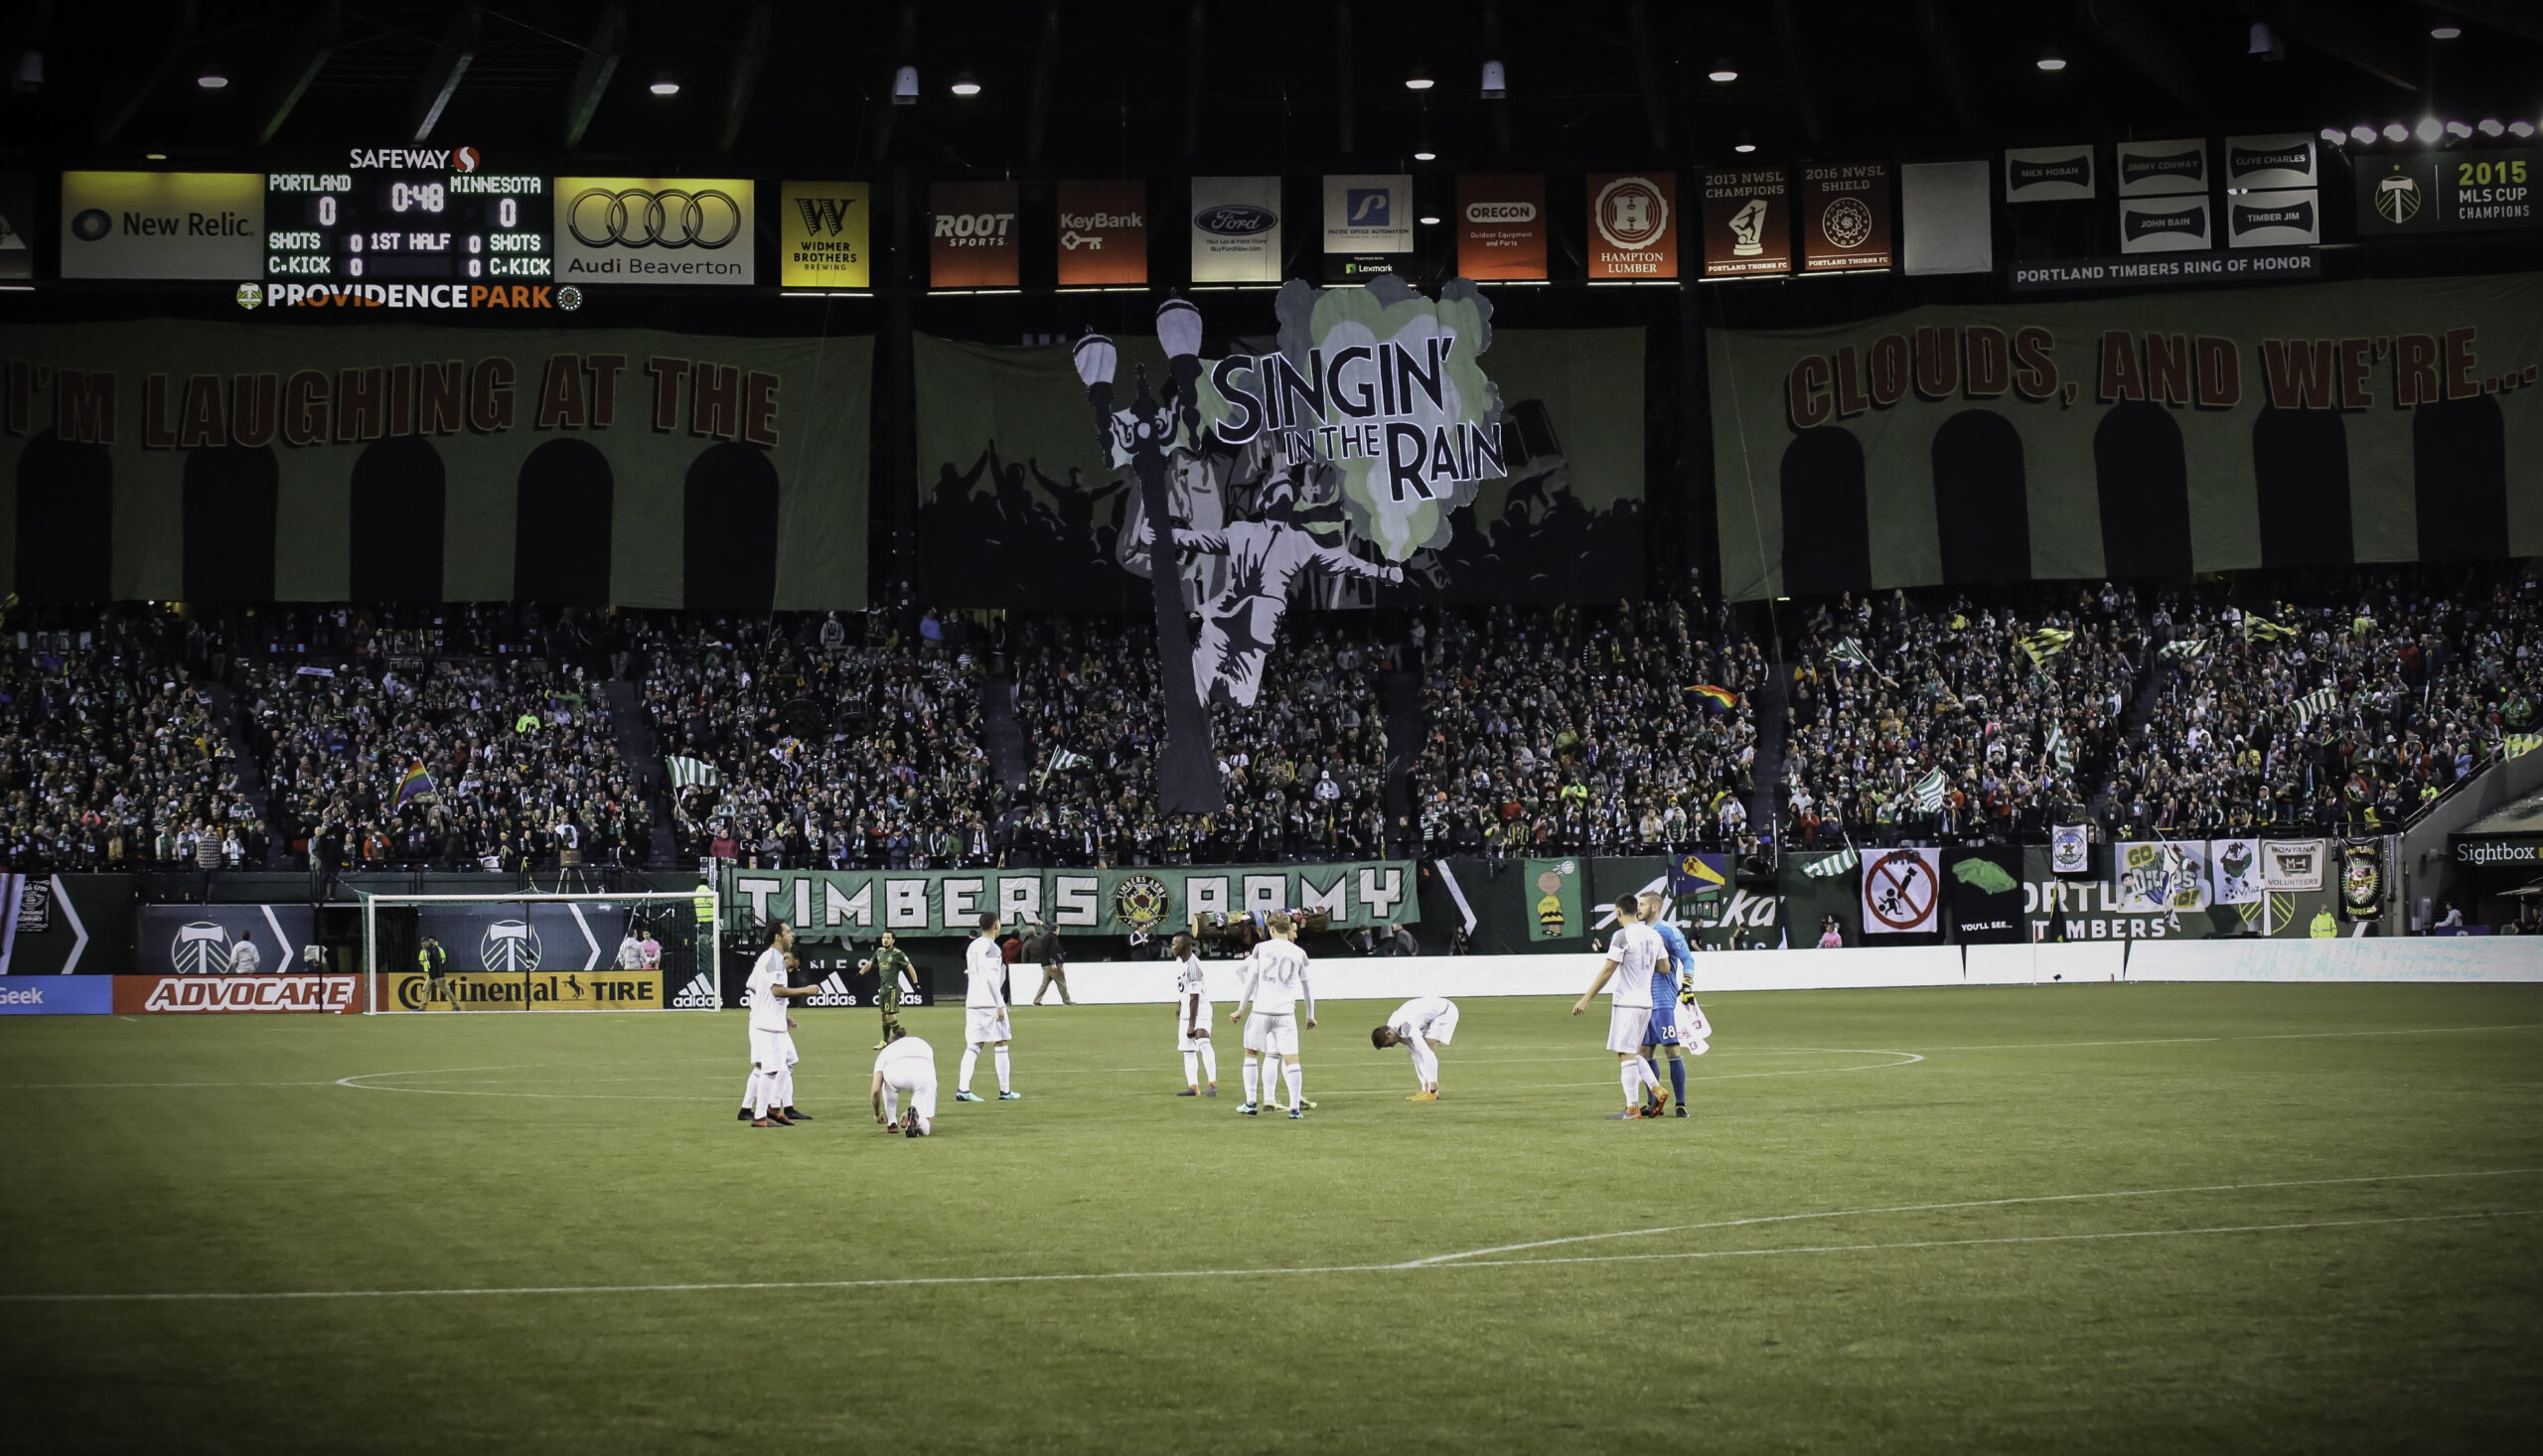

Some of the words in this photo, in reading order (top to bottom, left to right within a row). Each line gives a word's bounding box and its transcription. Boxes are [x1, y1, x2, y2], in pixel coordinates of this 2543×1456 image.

[350, 149, 450, 169] SAFEWAY
[2127, 162, 2156, 173] JIMMY
[2158, 159, 2199, 171] CONWAY
[2236, 156, 2264, 166] CLIVE
[2266, 153, 2307, 164] CHARLES
[1706, 174, 1737, 186] 2013
[1741, 172, 1784, 184] NWSL
[1805, 168, 1839, 180] 2016
[1843, 166, 1885, 178] NWSL
[2021, 168, 2044, 178] MICK
[2047, 165, 2079, 176] HOBAN
[2459, 161, 2526, 186] 2015
[269, 174, 351, 192] PORTLAND
[450, 176, 541, 195] MINNESOTA
[1706, 184, 1785, 199] CHAMPIONS
[1821, 179, 1870, 192] SHIELD
[391, 183, 444, 213] 0:48
[2458, 189, 2489, 204] MLS
[2493, 187, 2528, 203] CUP
[319, 197, 336, 225] 0
[500, 198, 517, 226] 0
[1211, 210, 1261, 230] Ford
[1470, 205, 1531, 219] OREGON
[2247, 213, 2281, 222] TIMBER
[2284, 211, 2301, 221] JIM
[2459, 204, 2530, 220] CHAMPIONS
[123, 213, 179, 236] New
[189, 212, 249, 237] Relic
[935, 214, 1014, 237] ROOT
[1061, 213, 1142, 231] KeyBank
[2141, 218, 2164, 228] JOHN
[2166, 216, 2190, 226] BAIN
[269, 232, 321, 250] SHOTS
[350, 233, 363, 252] 0
[371, 232, 399, 250] 1ST
[409, 232, 451, 250] HALF
[469, 235, 481, 254] 0
[490, 233, 541, 251] SHOTS
[801, 241, 850, 252] WIDMER
[950, 237, 1006, 247] SPORTS
[269, 256, 331, 274] C.KICK
[350, 257, 363, 276] 0
[568, 258, 622, 274] Audi
[629, 258, 742, 275] Beaverton
[794, 252, 857, 263] BROTHERS
[1601, 252, 1664, 263] HAMPTON
[469, 258, 481, 277] 0
[490, 258, 550, 277] C.KICK
[1359, 263, 1393, 273] Lexmark
[1607, 263, 1657, 274] LUMBER
[1708, 264, 1745, 273] PORTLAND
[1746, 263, 1775, 272] THORNS
[2017, 266, 2104, 283] PORTLAND
[2108, 262, 2179, 279] TIMBERS
[2184, 259, 2223, 275] RING
[2227, 257, 2249, 272] OF
[2253, 255, 2312, 270] HONOR
[1789, 326, 2079, 429] CLOUDS,
[2101, 329, 2242, 408] AND
[1211, 335, 1456, 445] SINGIN'
[6, 358, 116, 444] I'M
[146, 356, 518, 449] LAUGHING
[537, 353, 627, 428] AT
[650, 356, 781, 448] THE
[1283, 430, 1317, 467] IN
[1321, 422, 1382, 461] THE
[1385, 421, 1508, 504] RAIN
[2129, 845, 2154, 866] GO
[2457, 842, 2536, 866] Sightbox
[1117, 876, 1146, 899] TIMBERS
[1148, 879, 1167, 898] ARMY
[738, 875, 1099, 929] TIMBERS
[1961, 922, 1989, 932] YOU'LL
[2035, 918, 2166, 940] TMBERS
[1263, 956, 1295, 985] 20
[149, 978, 354, 1007] ADVOCARE
[591, 980, 654, 1001] TIRE
[806, 993, 857, 1007] adidas
[1661, 1025, 1676, 1040] 28
